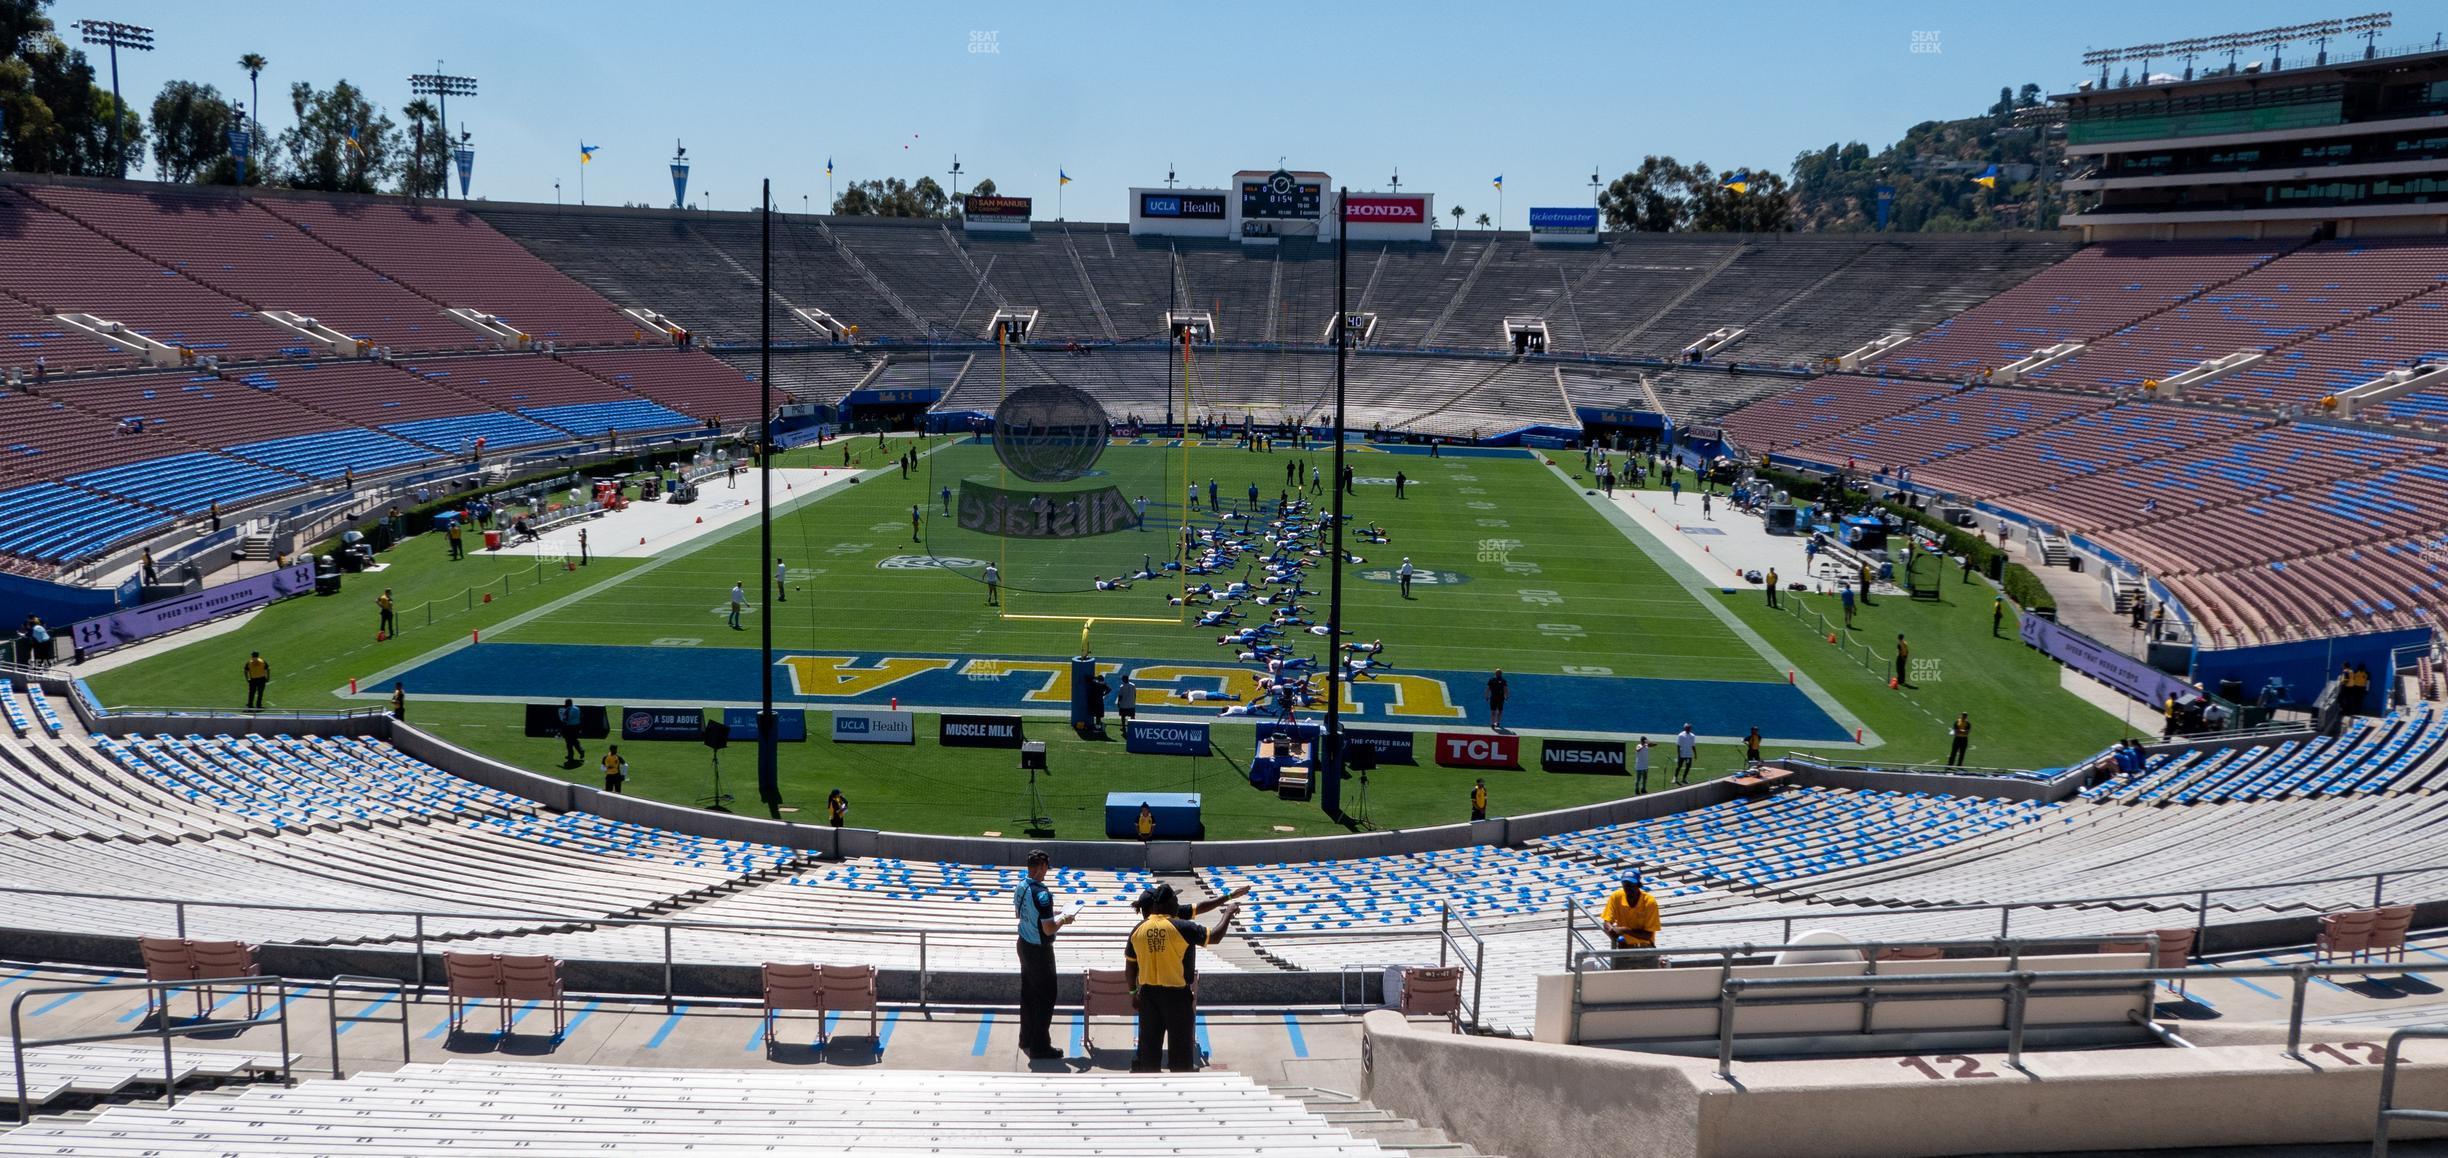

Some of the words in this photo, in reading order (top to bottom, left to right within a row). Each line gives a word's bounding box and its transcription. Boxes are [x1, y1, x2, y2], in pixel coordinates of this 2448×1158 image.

[997, 200, 1029, 208] MANUEL
[1150, 202, 1176, 211] UCLA
[1183, 201, 1220, 213] Health
[1347, 205, 1416, 216] HONDA
[1532, 213, 1592, 221] ticketmaster
[1348, 316, 1361, 326] 40
[157, 608, 182, 621] SPEED
[184, 602, 204, 614] THAT
[206, 596, 229, 608] NEVER
[231, 589, 253, 601] STOPS
[2066, 644, 2082, 656] SPEED
[2084, 652, 2098, 664] THAT
[2099, 658, 2118, 674] NEVER
[2118, 667, 2139, 683] STOPS
[773, 655, 1467, 718] UCLA
[654, 715, 659, 723] A
[661, 715, 674, 724] SUB
[676, 716, 699, 724] ABOVE
[841, 720, 865, 730] UCLA
[872, 720, 908, 732] Health
[946, 724, 986, 736] MUSCLE
[988, 725, 1014, 738] MILK
[1135, 727, 1188, 740] WESCOM
[1447, 739, 1508, 760] TCL
[1545, 749, 1624, 764] NISSAN
[2308, 1042, 2413, 1066] 12
[1898, 1055, 2000, 1080] 12
